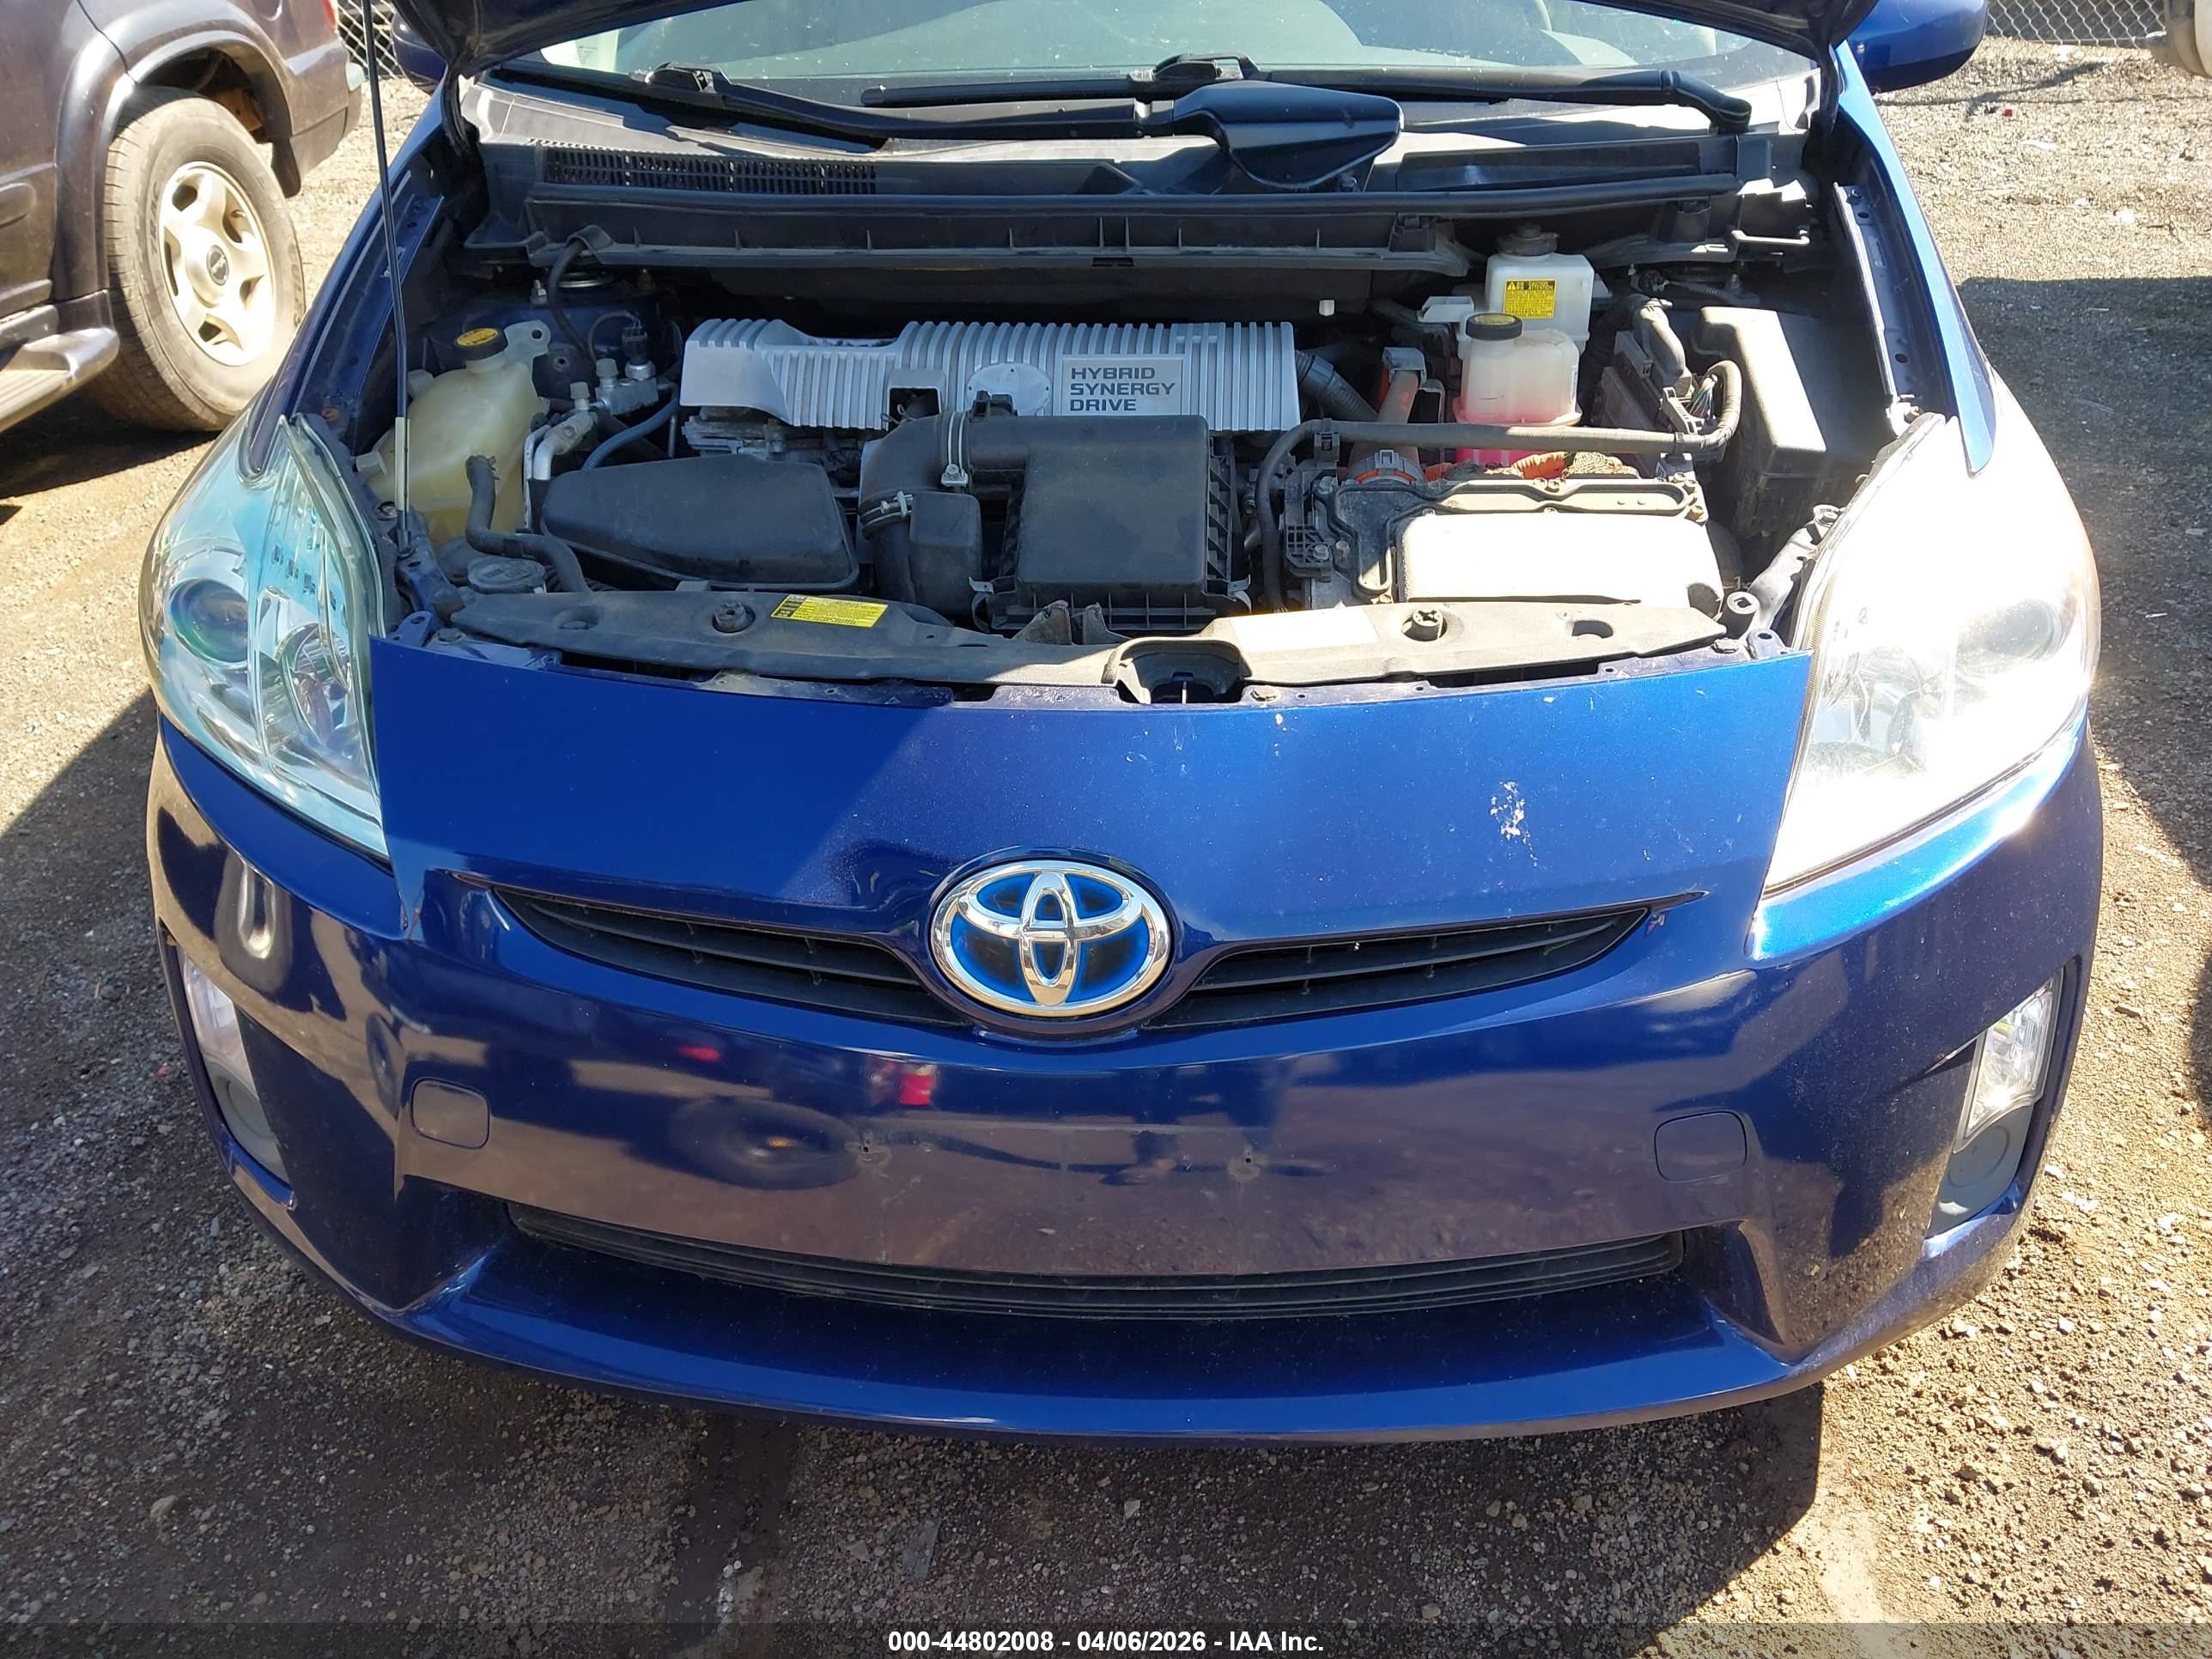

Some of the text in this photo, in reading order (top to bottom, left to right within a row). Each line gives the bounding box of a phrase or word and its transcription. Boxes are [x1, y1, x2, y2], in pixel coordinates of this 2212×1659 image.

[1071, 367, 1156, 380] HYBRID
[1070, 382, 1176, 396] SYNERGY
[1070, 398, 1137, 411] DRIVE
